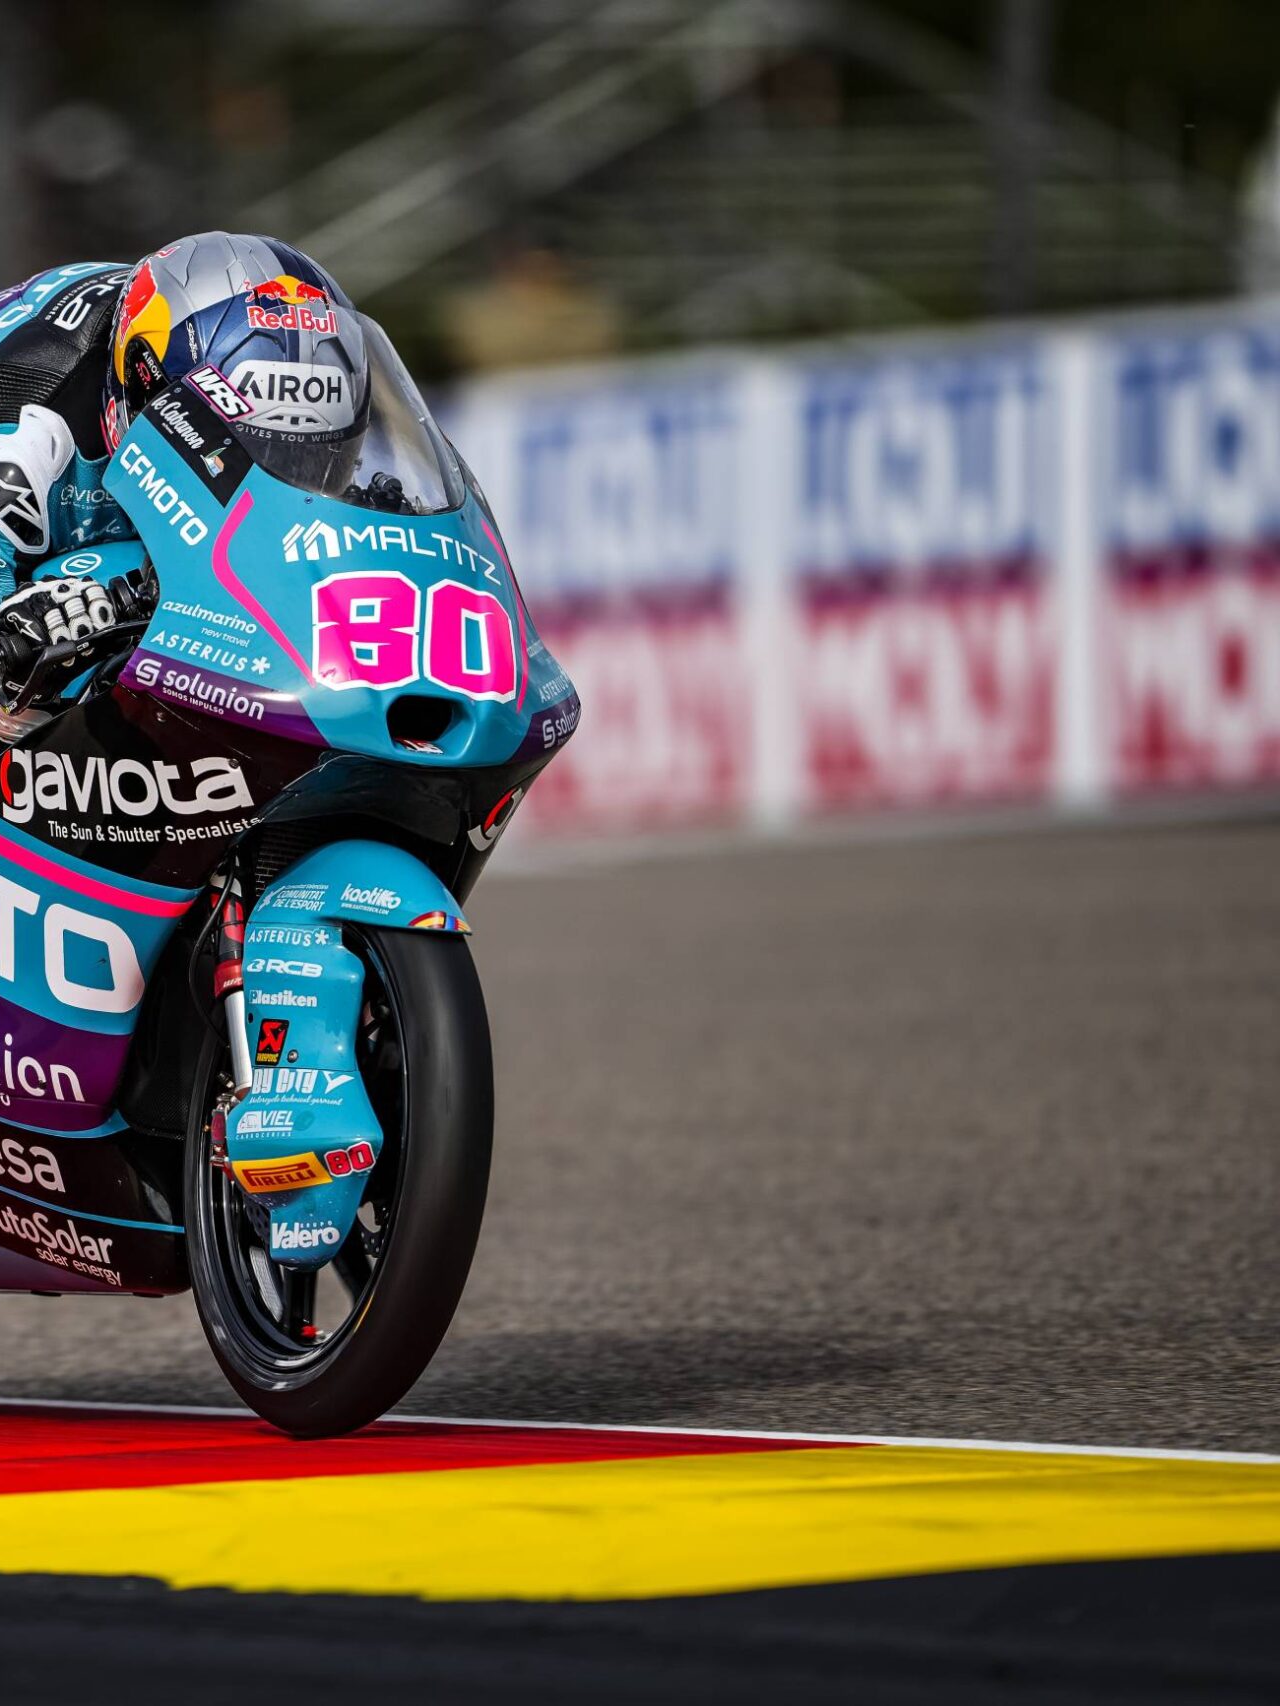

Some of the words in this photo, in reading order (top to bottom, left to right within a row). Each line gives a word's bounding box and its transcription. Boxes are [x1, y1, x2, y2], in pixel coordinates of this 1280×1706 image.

[247, 305, 297, 330] Red
[300, 308, 339, 335] Bull
[191, 367, 250, 415] WRS
[237, 371, 342, 403] AIROH
[280, 433, 305, 443] YOU
[120, 442, 209, 546] CFMOTO
[343, 524, 501, 586] MALTITZ
[161, 600, 257, 634] azulmarino
[150, 629, 248, 673] ASTERIUS
[312, 570, 517, 704] 80
[163, 669, 265, 721] solunion
[0, 748, 255, 823] gaviota
[48, 820, 68, 838] The
[71, 823, 93, 841] Sun
[96, 826, 105, 841] &
[108, 826, 161, 843] Shutter
[164, 816, 266, 844] Specialists
[248, 929, 312, 947] ASTERIUS
[265, 958, 323, 978] RCB
[263, 1110, 294, 1126] VIEL
[242, 1162, 317, 1188] PIRELLI
[323, 1141, 377, 1177] 80
[271, 1222, 340, 1249] Valero
[35, 1246, 69, 1267] solar
[72, 1259, 122, 1287] energy
